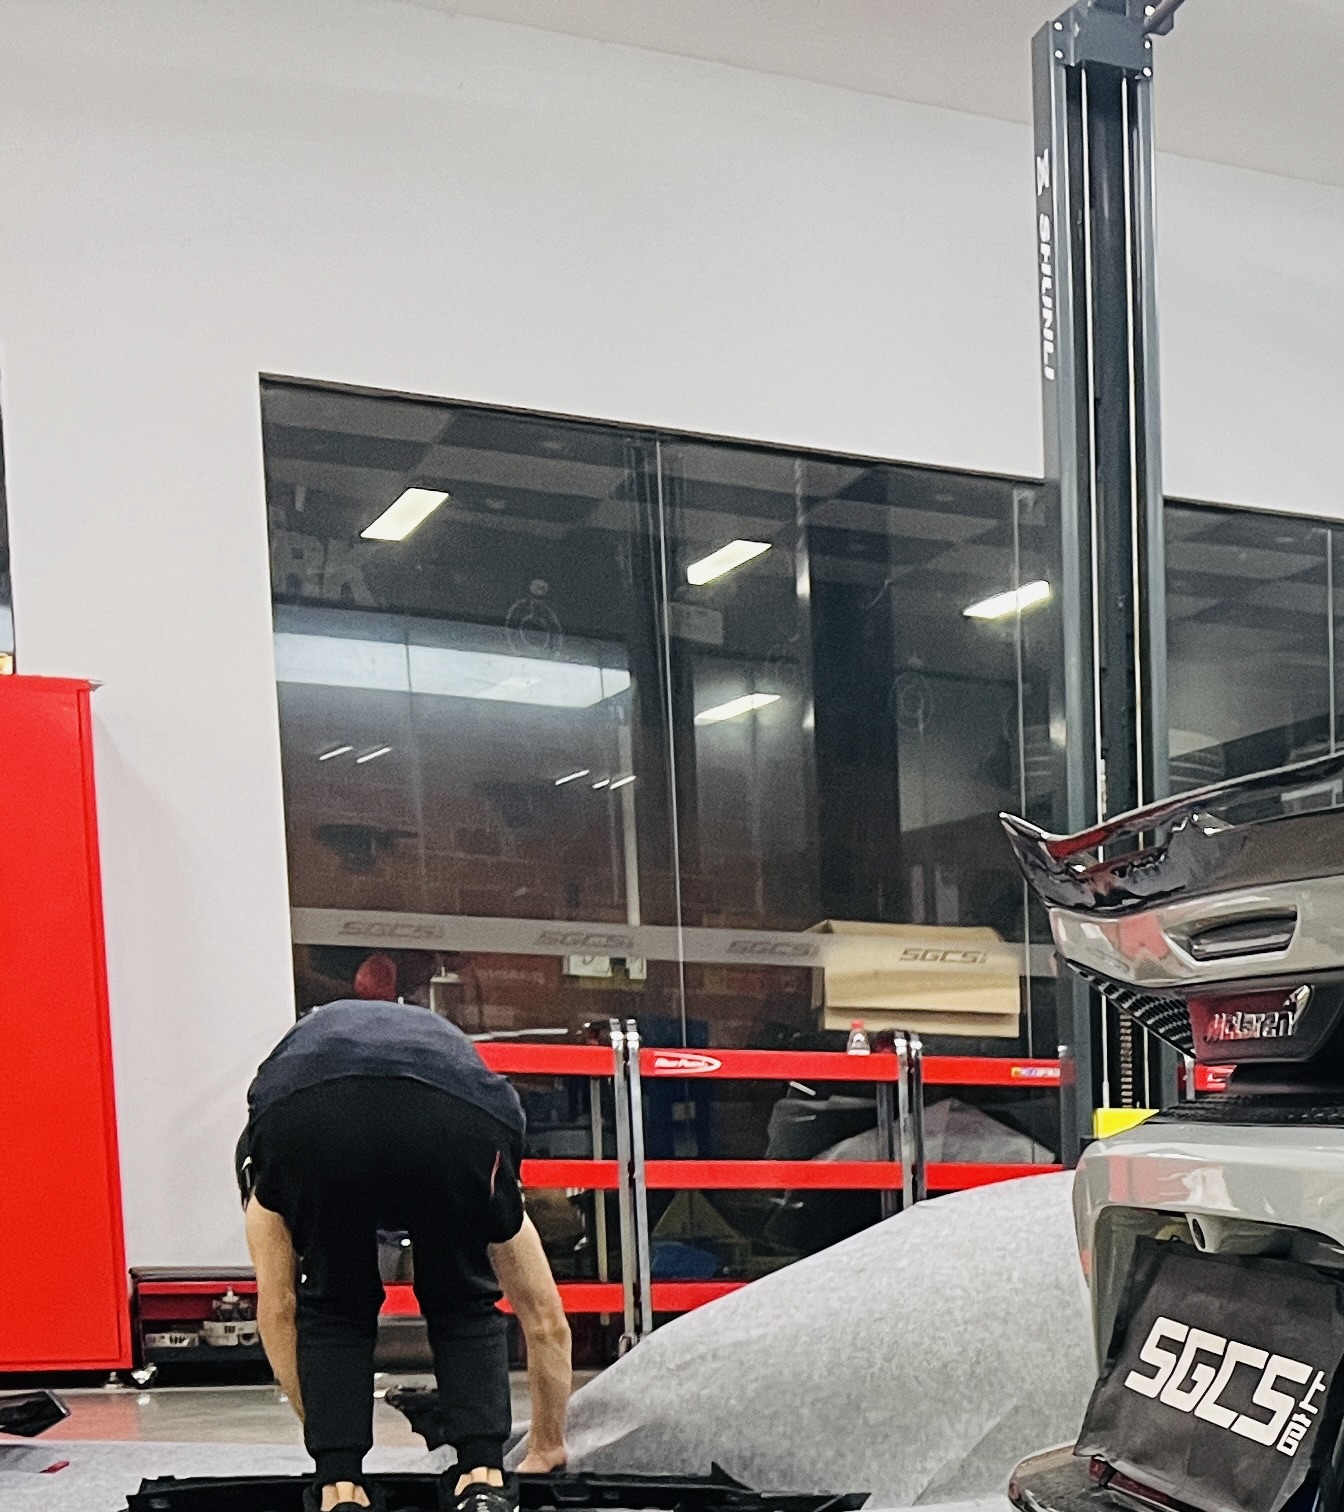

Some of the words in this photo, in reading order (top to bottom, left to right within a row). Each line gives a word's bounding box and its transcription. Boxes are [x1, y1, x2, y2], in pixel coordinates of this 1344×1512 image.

[1039, 213, 1055, 380] SHUNLI
[900, 947, 980, 964] SGCS
[1124, 1316, 1313, 1447] SGCS
